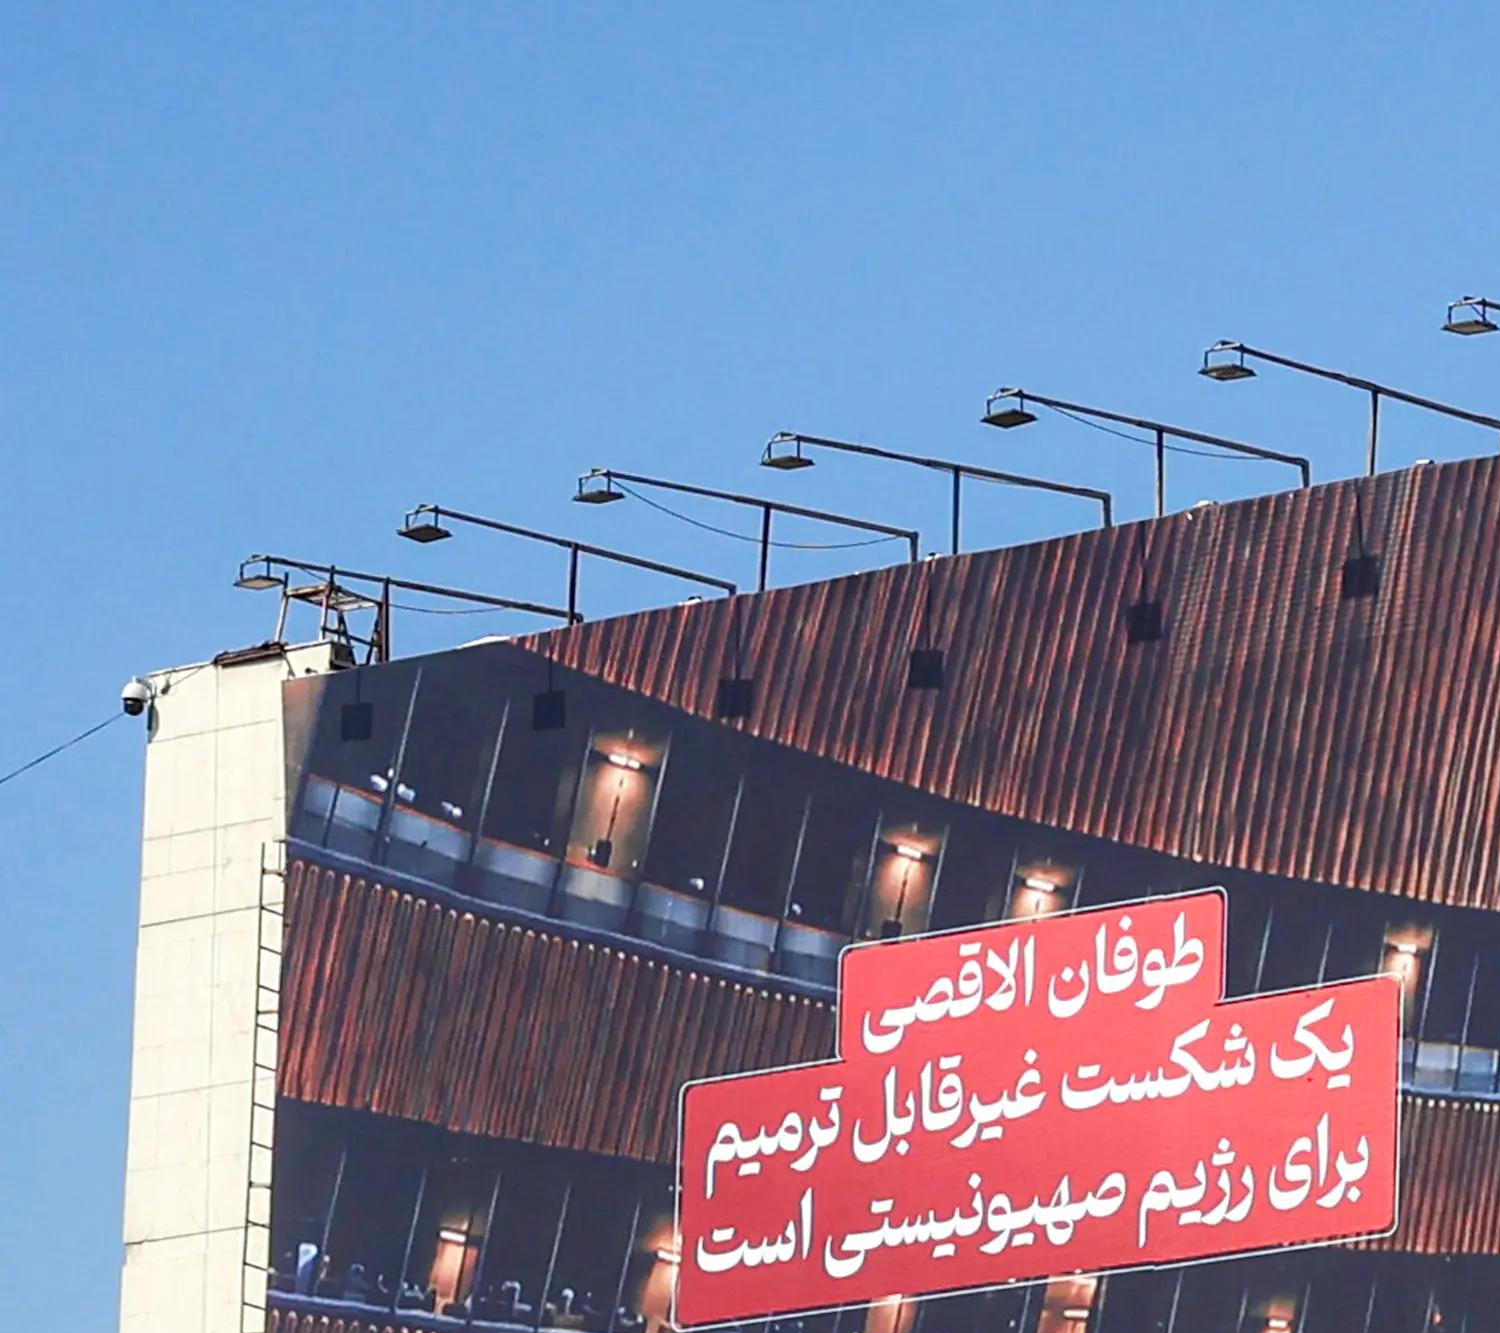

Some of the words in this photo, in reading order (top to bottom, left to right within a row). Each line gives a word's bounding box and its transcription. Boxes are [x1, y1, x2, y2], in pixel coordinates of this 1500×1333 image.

[862, 934, 1037, 1055] الاقصی
[1049, 911, 1206, 1018] طوفان
[1060, 1017, 1259, 1112] شکست
[1268, 999, 1355, 1091] یک
[705, 1086, 845, 1200] ترمیم
[1138, 1137, 1256, 1249] رژیم
[1268, 1112, 1370, 1210] برای
[695, 1187, 814, 1272] است
[822, 1166, 1128, 1280] صهیونیستی
